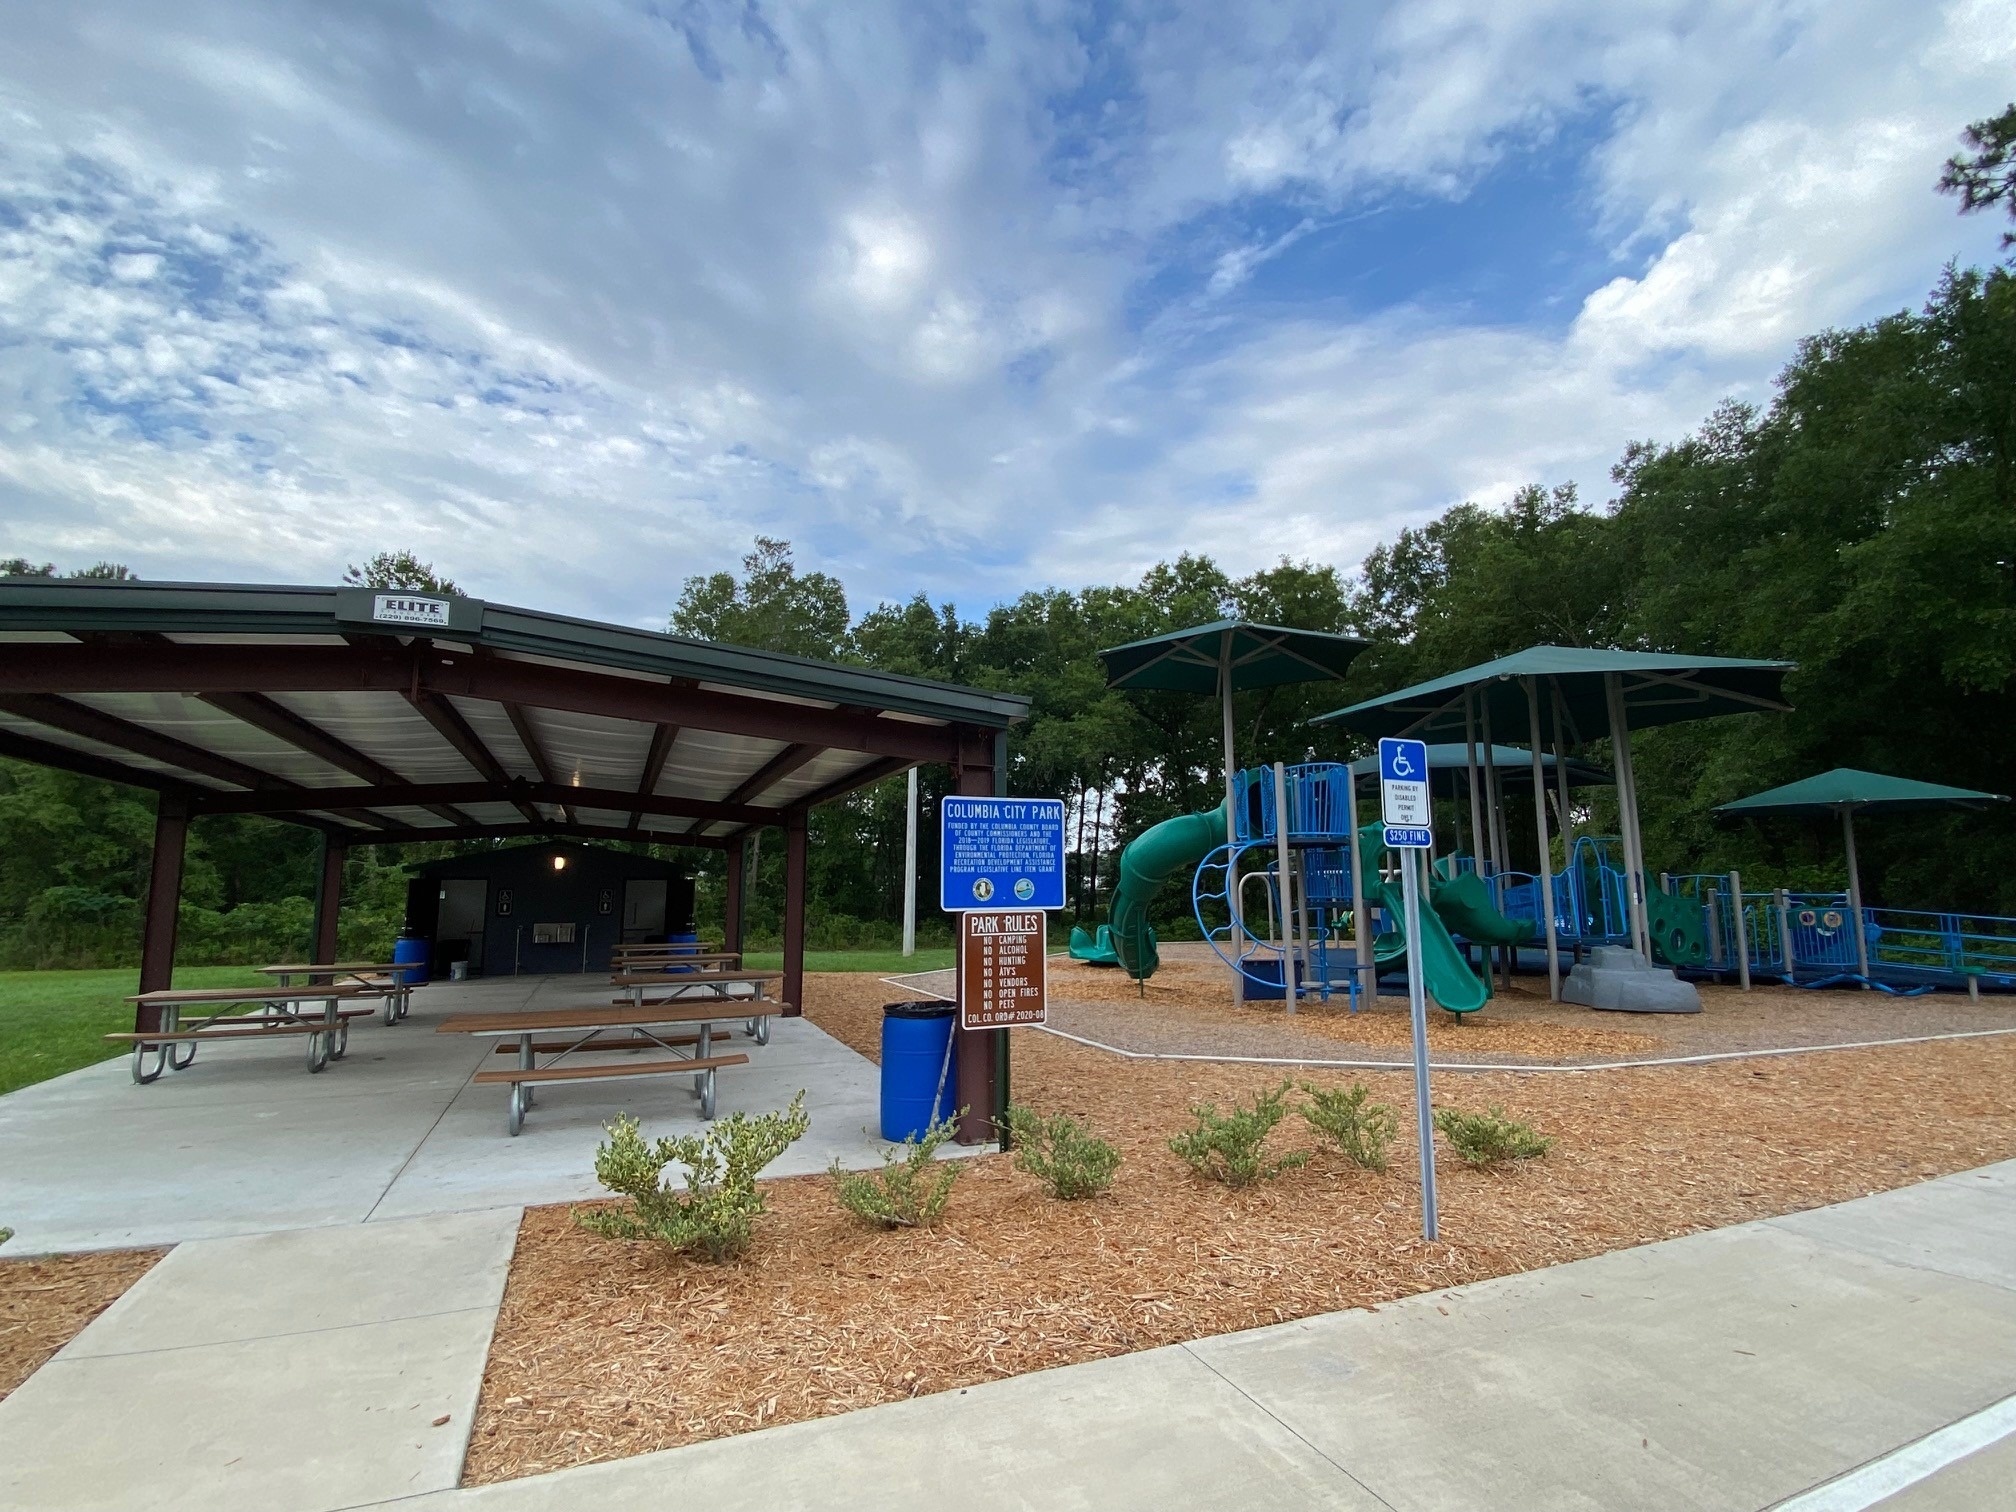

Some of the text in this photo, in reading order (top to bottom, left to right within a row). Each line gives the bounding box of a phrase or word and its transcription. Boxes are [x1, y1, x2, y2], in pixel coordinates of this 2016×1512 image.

[387, 600, 439, 613] ELITE
[405, 614, 444, 623] 896-7569
[947, 804, 1060, 820] COLUMBIA CITY PARK
[1390, 830, 1425, 842] $250 FINE
[971, 915, 1037, 933] PARK RULES
[983, 935, 1027, 945] NO CAMPING
[983, 945, 1028, 955] NO ALCOHOL
[983, 956, 1026, 966] NO HUNTING
[983, 967, 1016, 977] NO ATV'S
[983, 977, 1028, 988] NO VENDORS
[983, 987, 1039, 999] NO OPEN FIRES
[983, 1000, 1015, 1010] NO PETS
[1017, 1010, 1044, 1020] 2020-08
